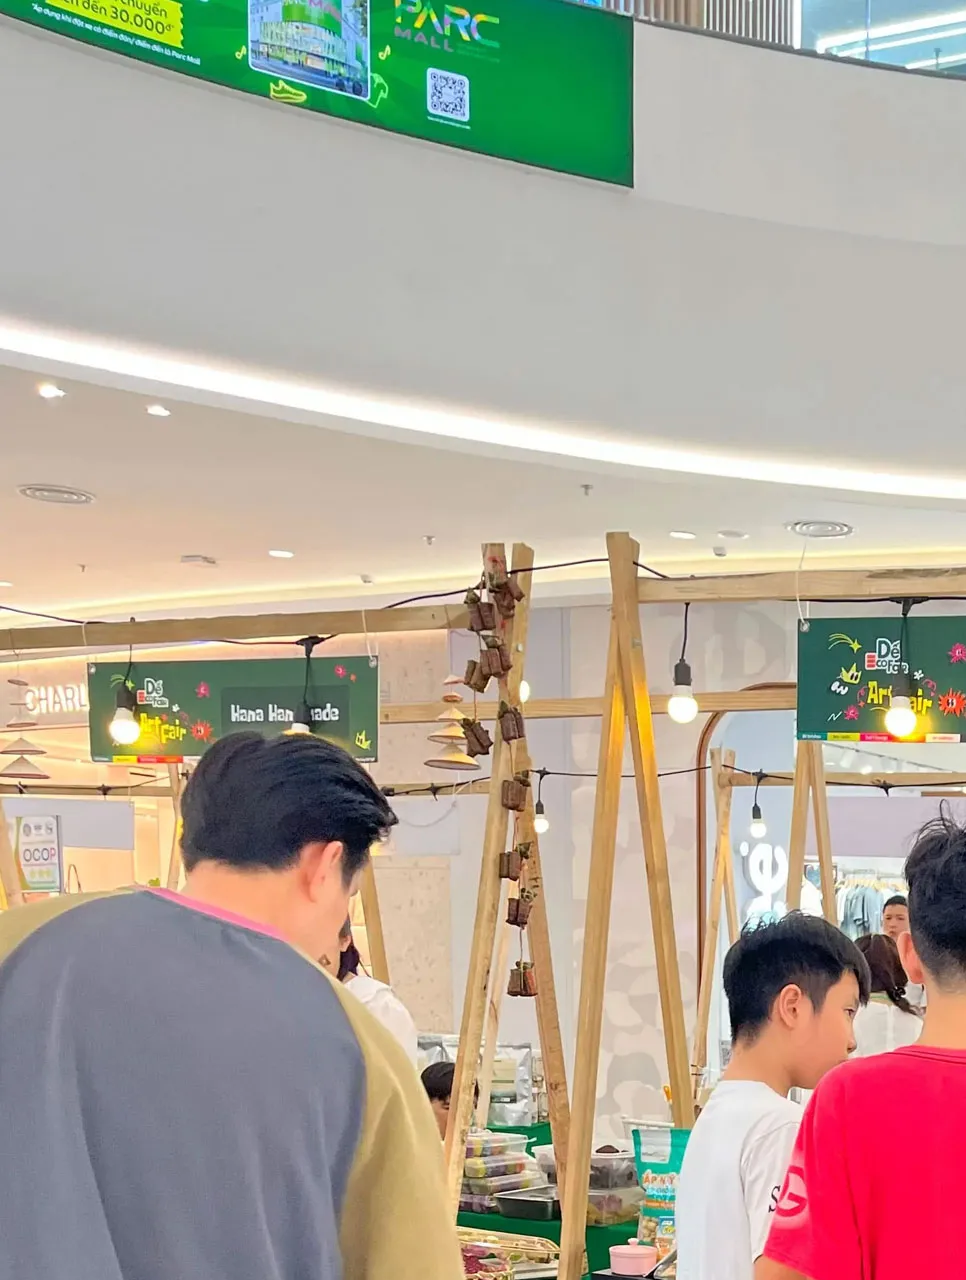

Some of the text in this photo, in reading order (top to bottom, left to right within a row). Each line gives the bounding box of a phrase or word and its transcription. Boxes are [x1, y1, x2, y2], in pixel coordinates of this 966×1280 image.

[395, 0, 499, 48] PARC
[394, 26, 454, 52] MALL
[171, 51, 186, 61] Parc
[230, 703, 339, 722] Hana Hanade
[160, 719, 187, 744] Fair
[23, 848, 56, 862] OCOP
